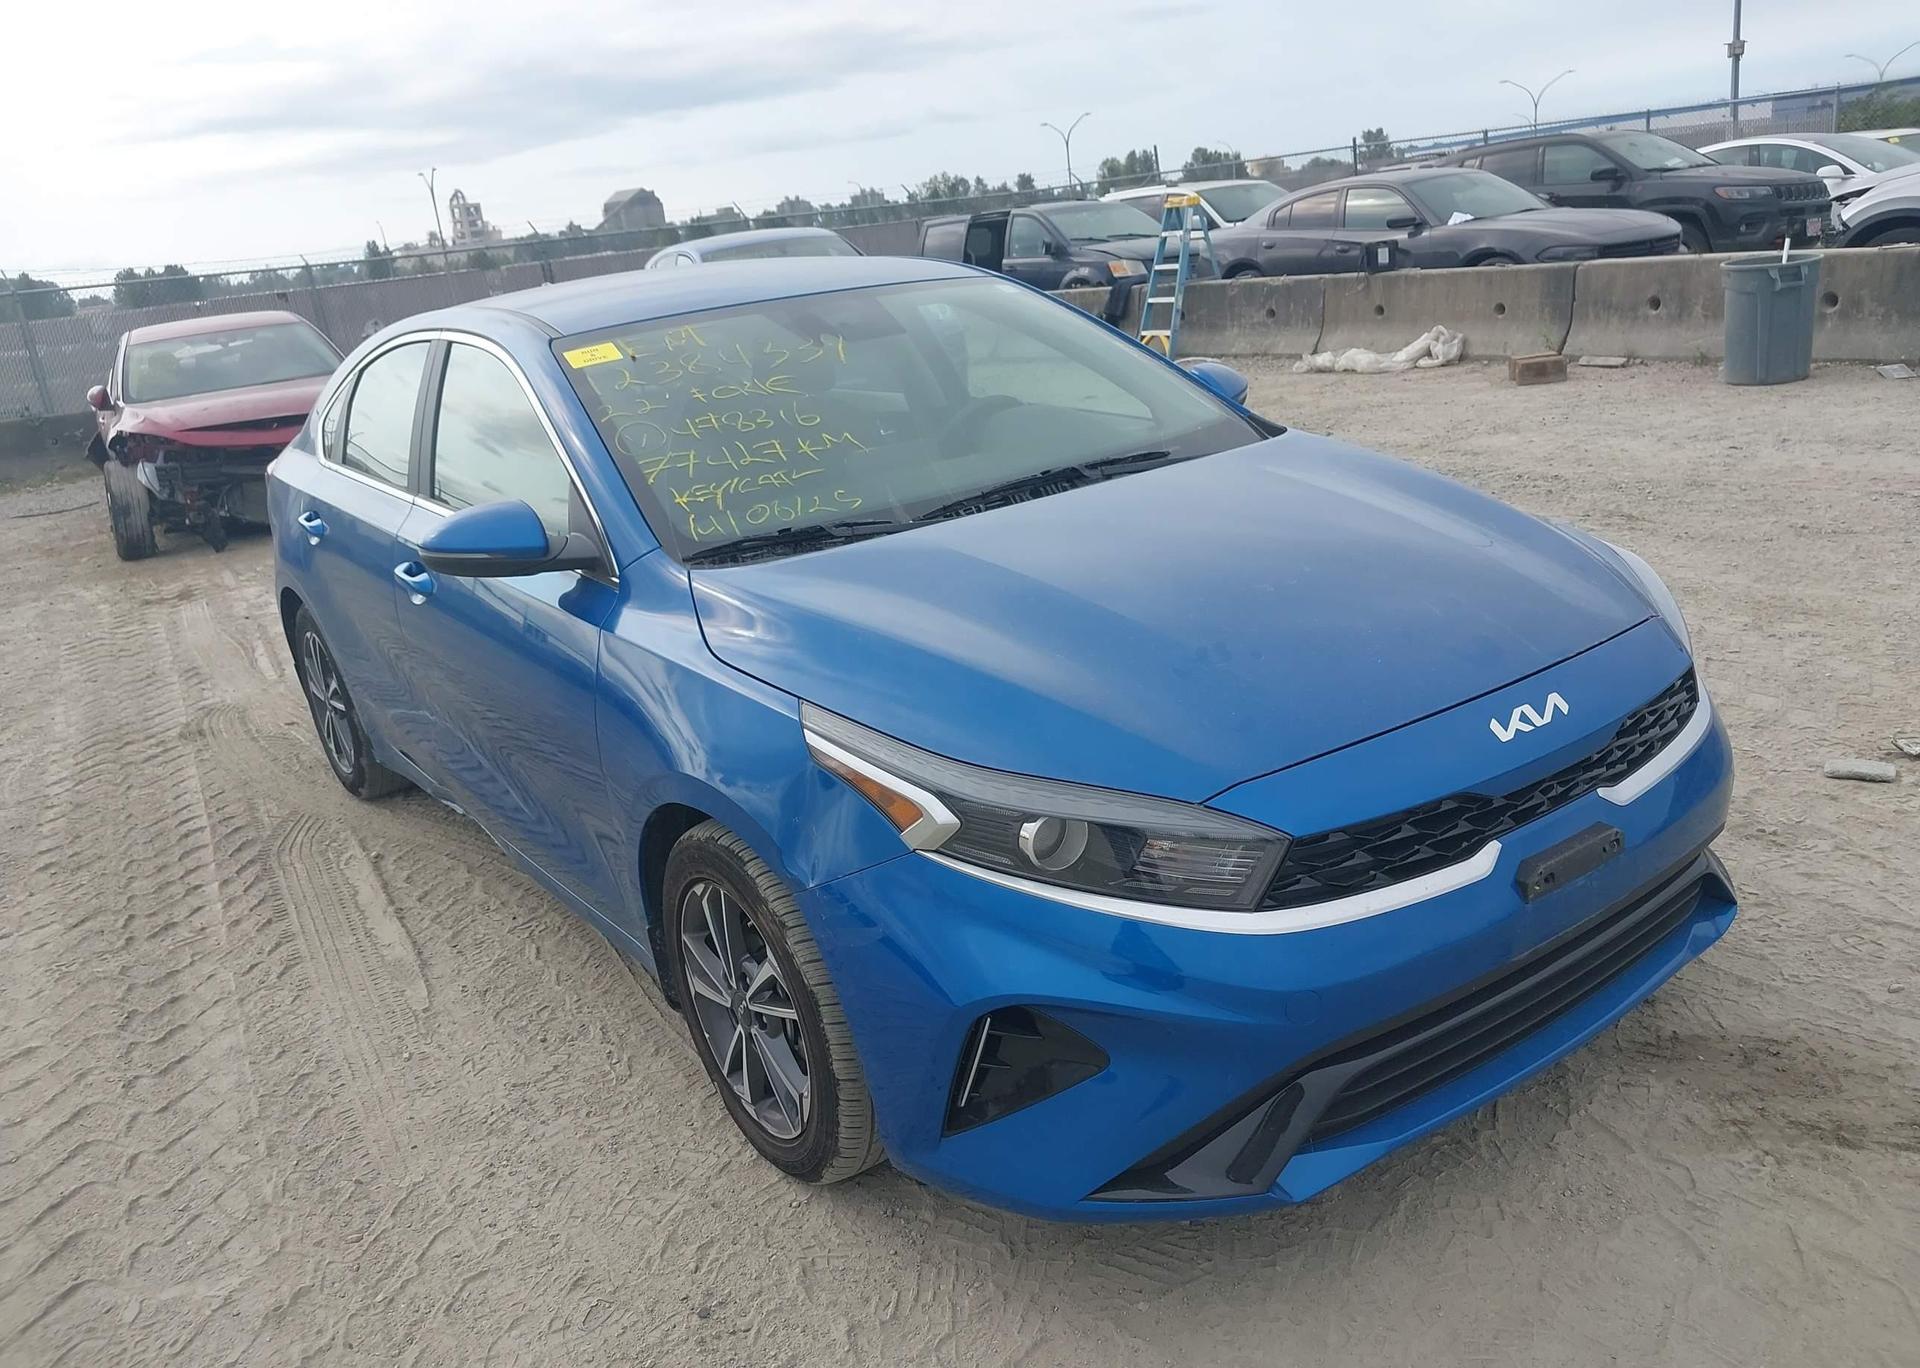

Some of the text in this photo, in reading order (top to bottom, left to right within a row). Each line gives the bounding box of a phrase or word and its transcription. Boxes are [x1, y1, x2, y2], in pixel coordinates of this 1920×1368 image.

[637, 432, 869, 486] 77427 KM
[1489, 691, 1570, 743] KIA
